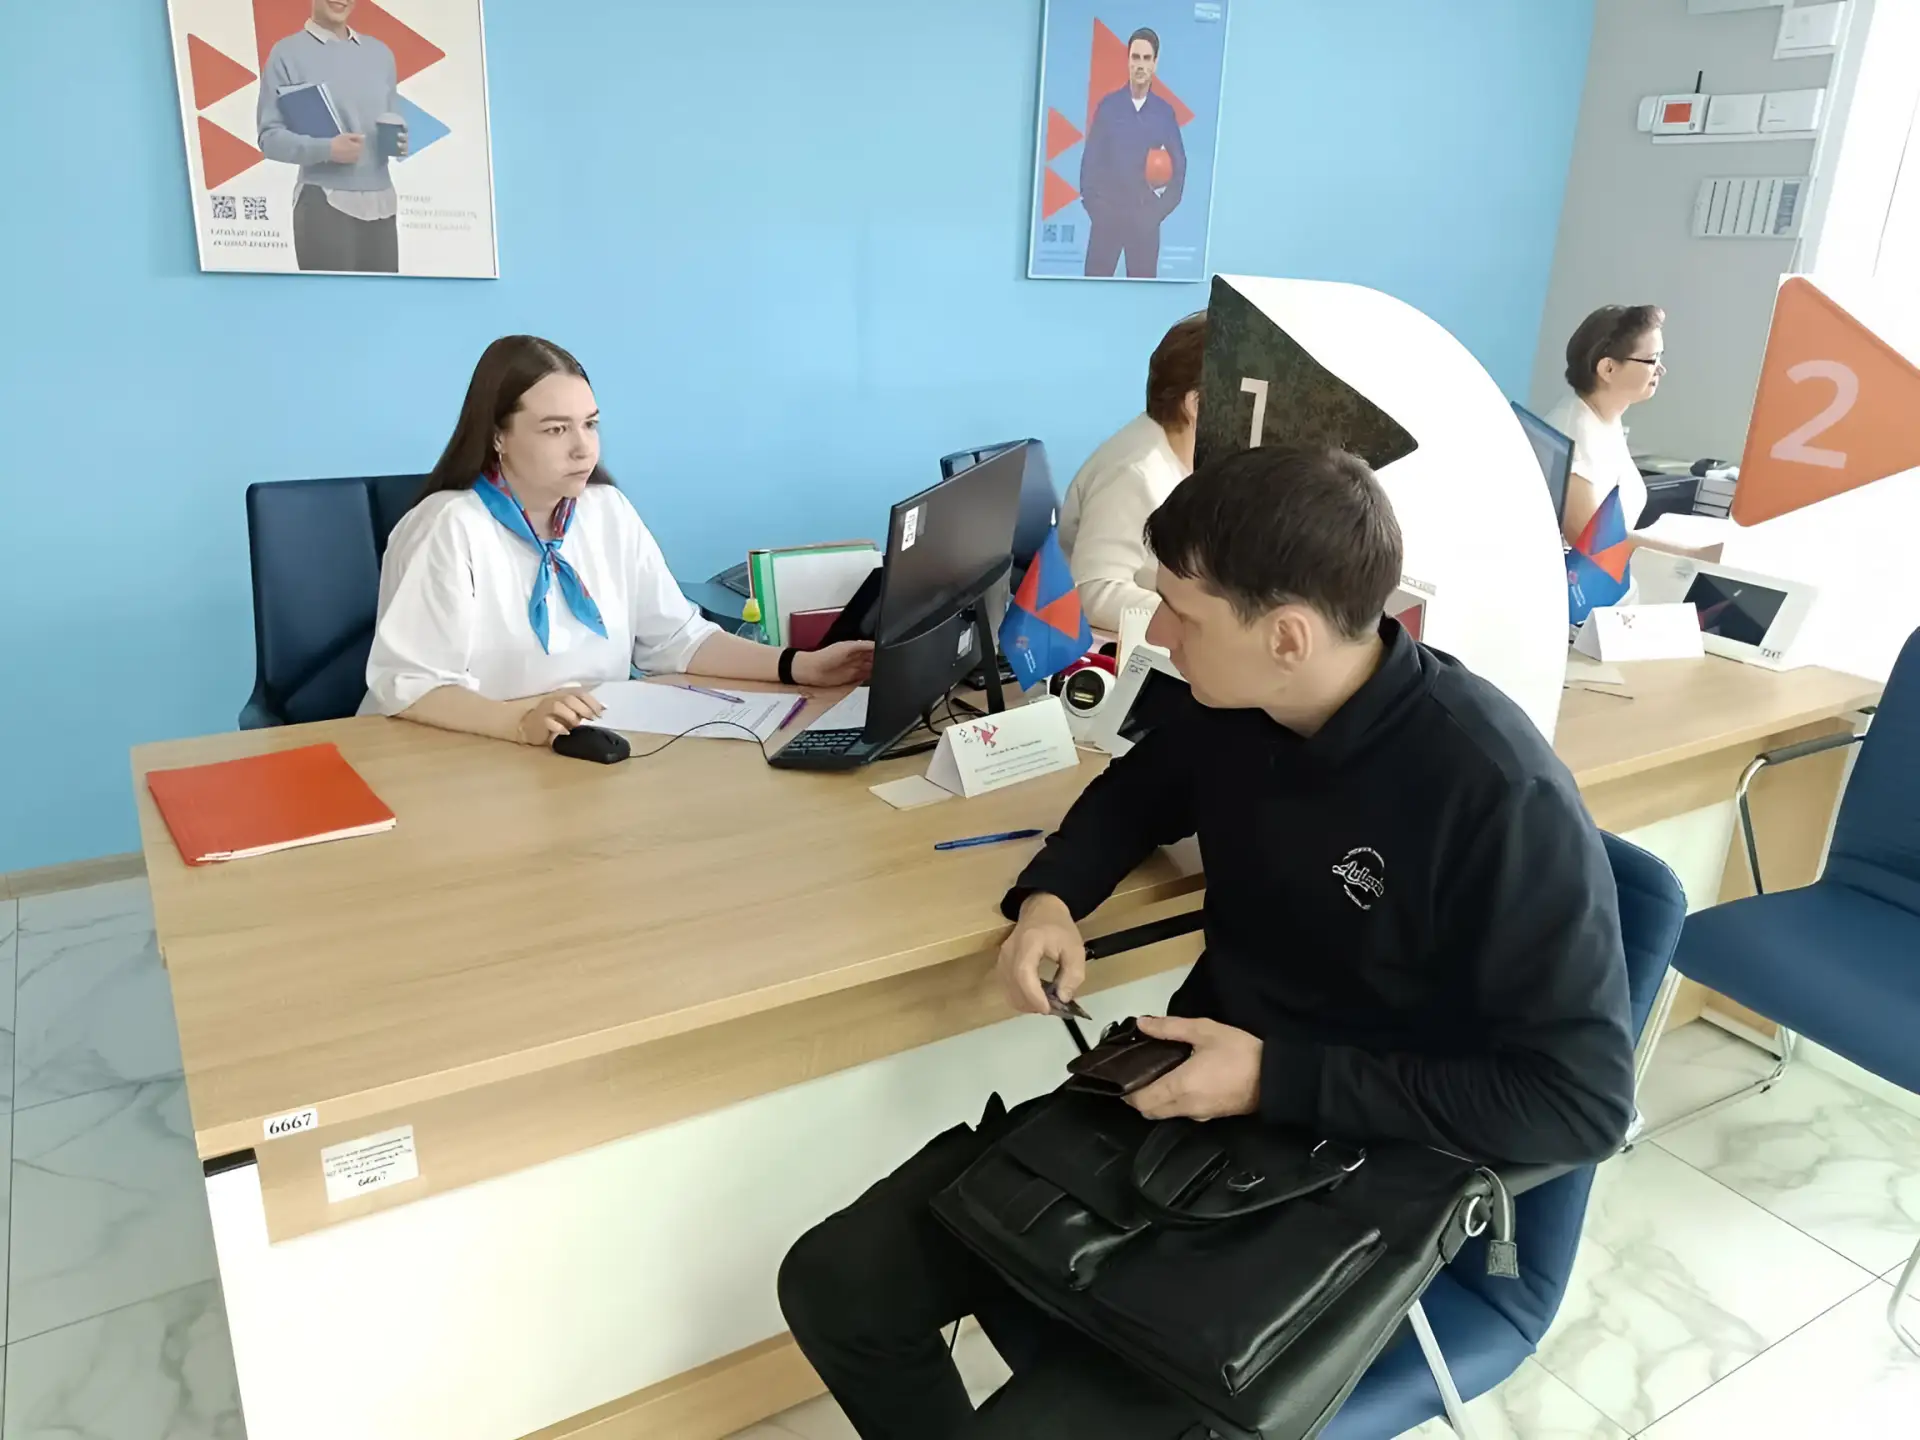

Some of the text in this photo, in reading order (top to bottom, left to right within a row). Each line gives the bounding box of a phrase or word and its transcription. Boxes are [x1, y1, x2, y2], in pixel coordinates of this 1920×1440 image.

[1240, 377, 1269, 450] 1
[1769, 359, 1860, 470] 2
[269, 1112, 312, 1135] 6667
